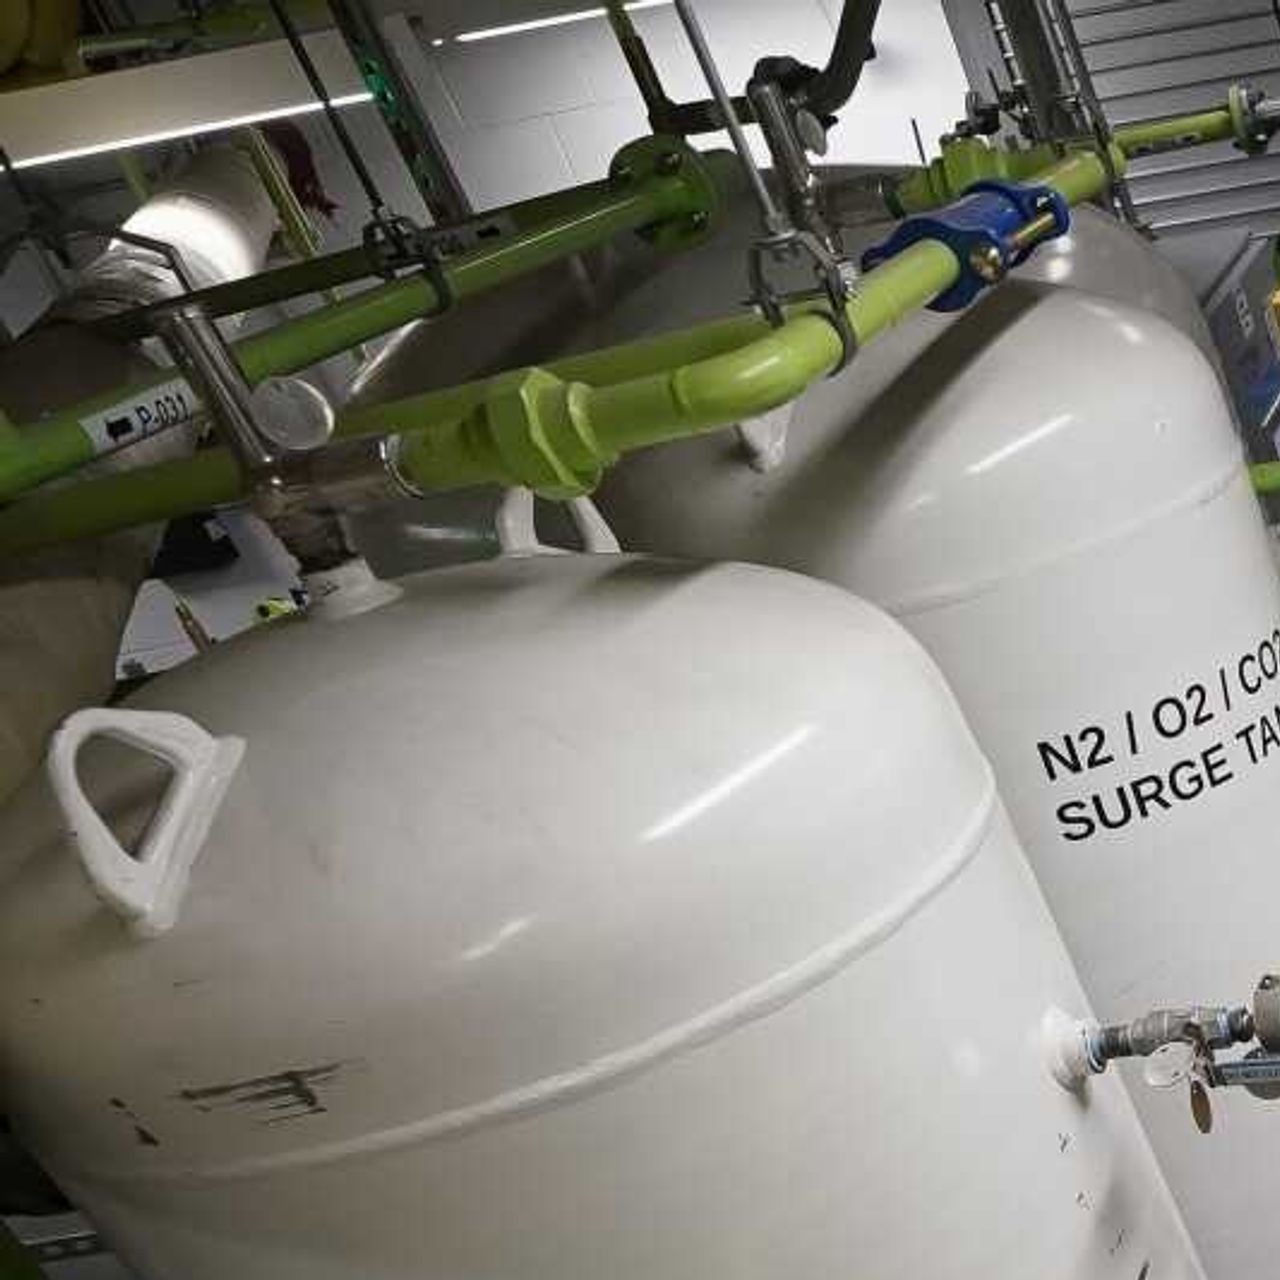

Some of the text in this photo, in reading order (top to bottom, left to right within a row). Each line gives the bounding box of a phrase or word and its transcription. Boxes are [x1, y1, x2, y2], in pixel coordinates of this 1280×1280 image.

[1037, 726, 1115, 782] N2
[1125, 710, 1139, 755] /
[1152, 683, 1215, 739] O2
[1218, 667, 1231, 712] /
[1055, 742, 1235, 842] SURGE
